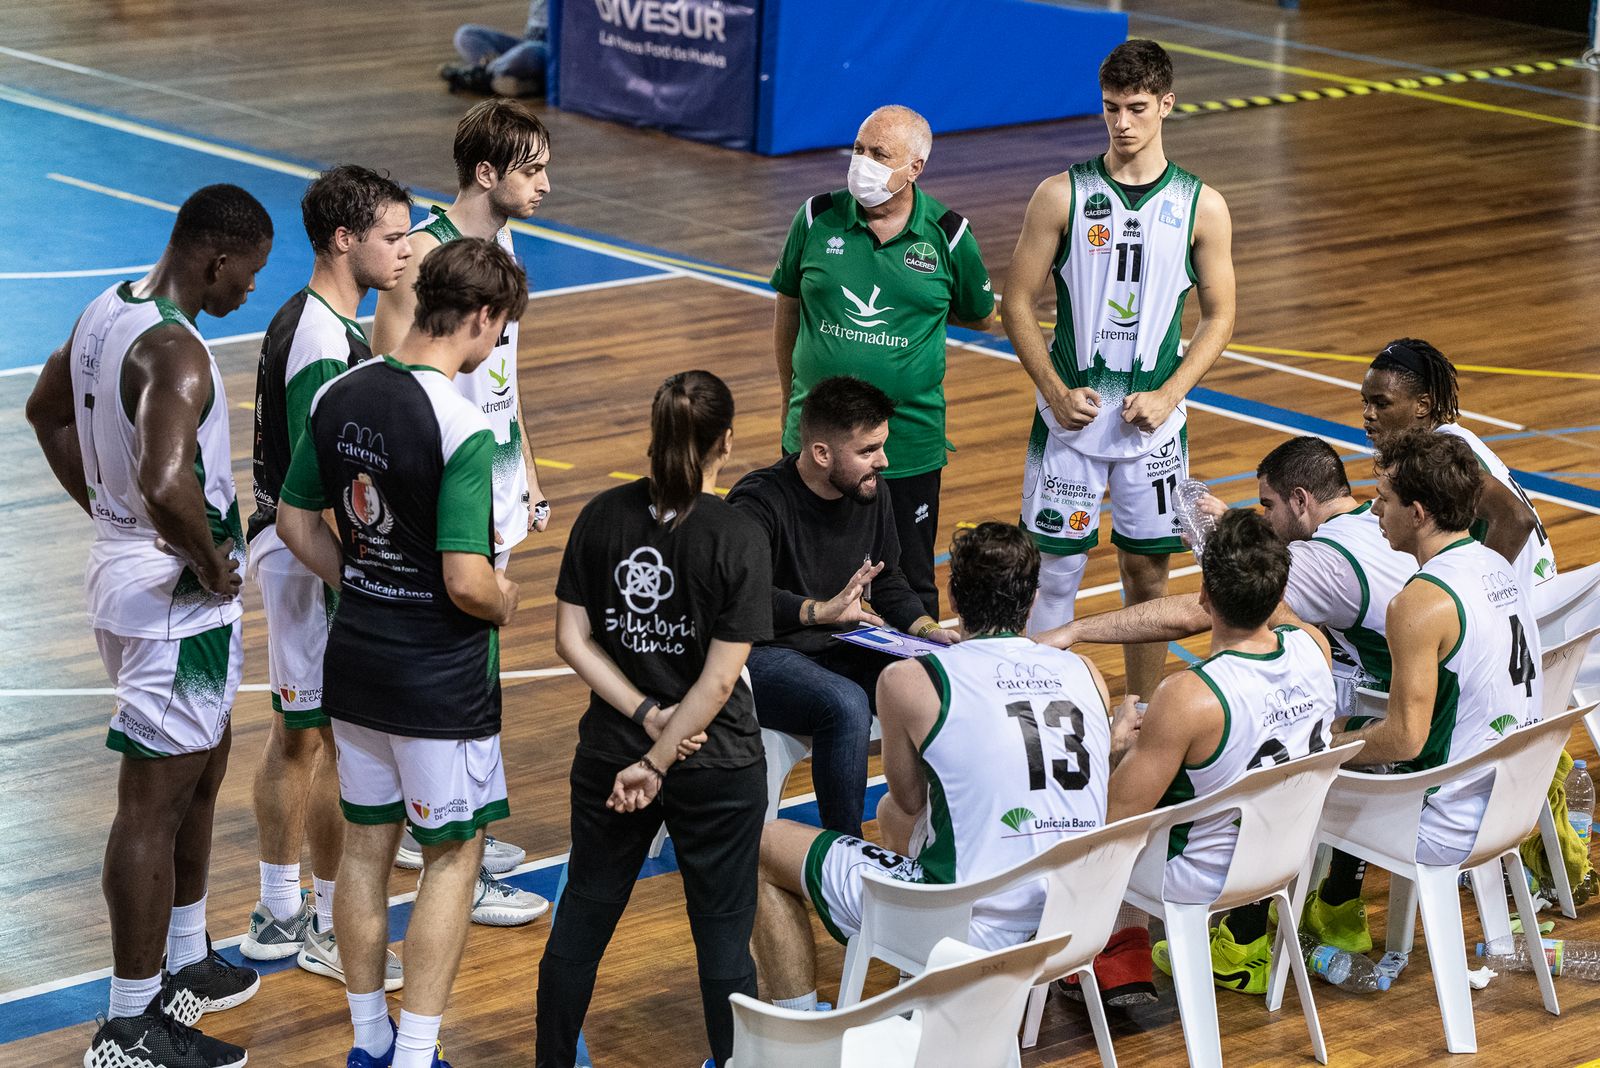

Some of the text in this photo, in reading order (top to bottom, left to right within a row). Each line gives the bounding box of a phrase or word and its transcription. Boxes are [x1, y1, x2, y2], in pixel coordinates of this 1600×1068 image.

[1160, 215, 1177, 226] EBA
[1115, 242, 1143, 283] 11
[820, 318, 909, 348] Extremadura
[1146, 455, 1180, 470] TOYOTA
[360, 579, 398, 597] Unicaja
[1508, 614, 1536, 698] 4
[299, 696, 309, 704] DE
[1005, 700, 1091, 791] 13
[1034, 816, 1096, 830] Unicaja Banco
